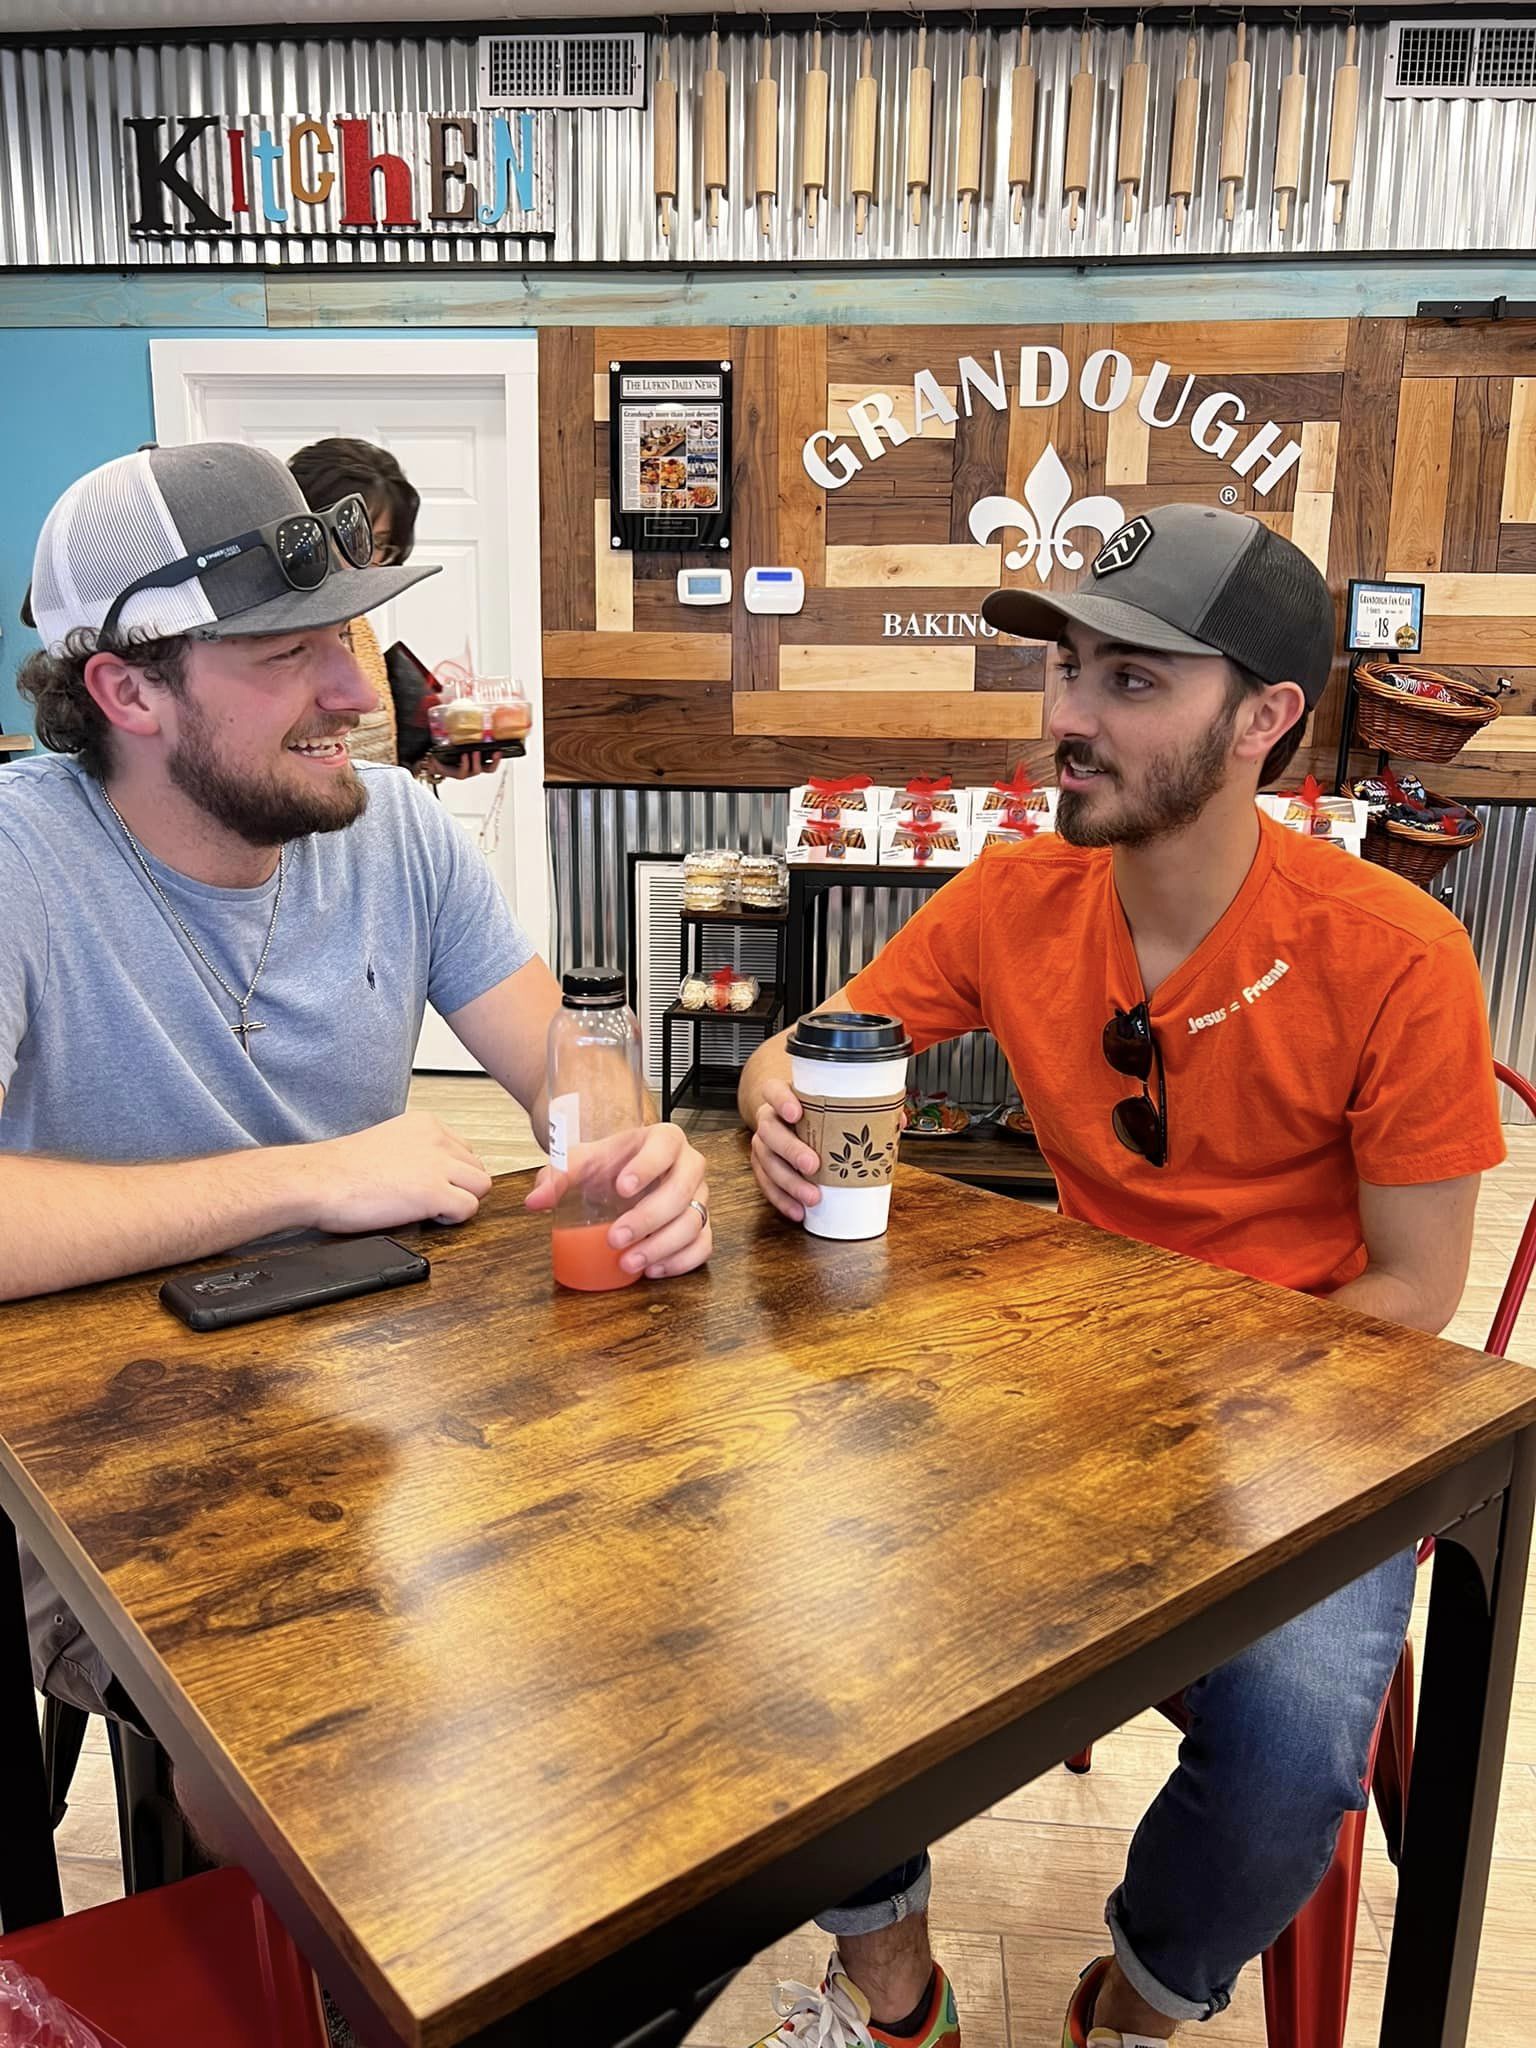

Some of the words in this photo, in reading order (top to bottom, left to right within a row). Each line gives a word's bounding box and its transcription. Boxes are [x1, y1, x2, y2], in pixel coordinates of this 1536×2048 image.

[625, 379, 641, 390] THE
[642, 379, 670, 390] LUFKIN
[671, 379, 693, 390] DAILY
[694, 379, 718, 390] NEWS
[623, 410, 653, 418] Grandough
[802, 345, 1304, 497] GRANDOUGH
[1187, 1007, 1227, 1035] Jesus
[1229, 1001, 1241, 1013] =
[1242, 958, 1290, 1005] Friend
